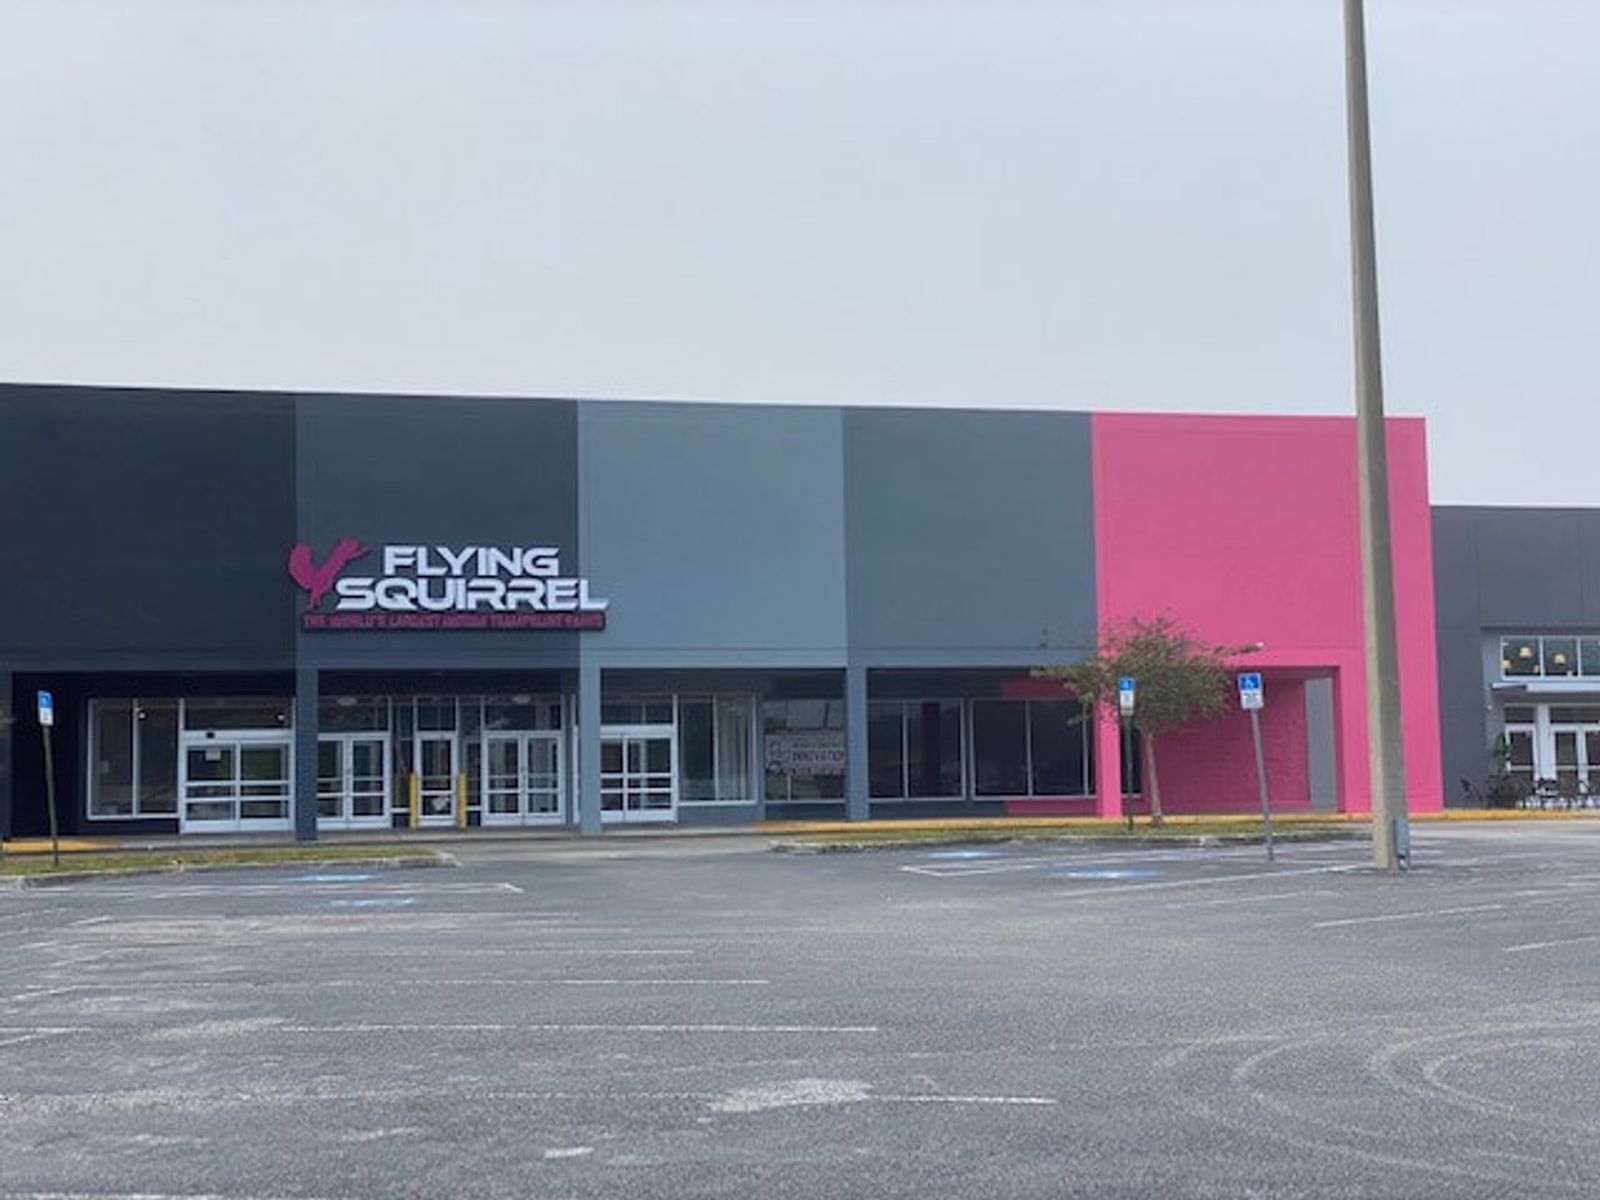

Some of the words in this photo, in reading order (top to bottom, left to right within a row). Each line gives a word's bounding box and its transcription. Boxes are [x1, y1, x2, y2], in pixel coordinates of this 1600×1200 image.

[383, 545, 560, 577] FLYING
[335, 577, 609, 610] SQUIRREL
[304, 613, 325, 628] THE
